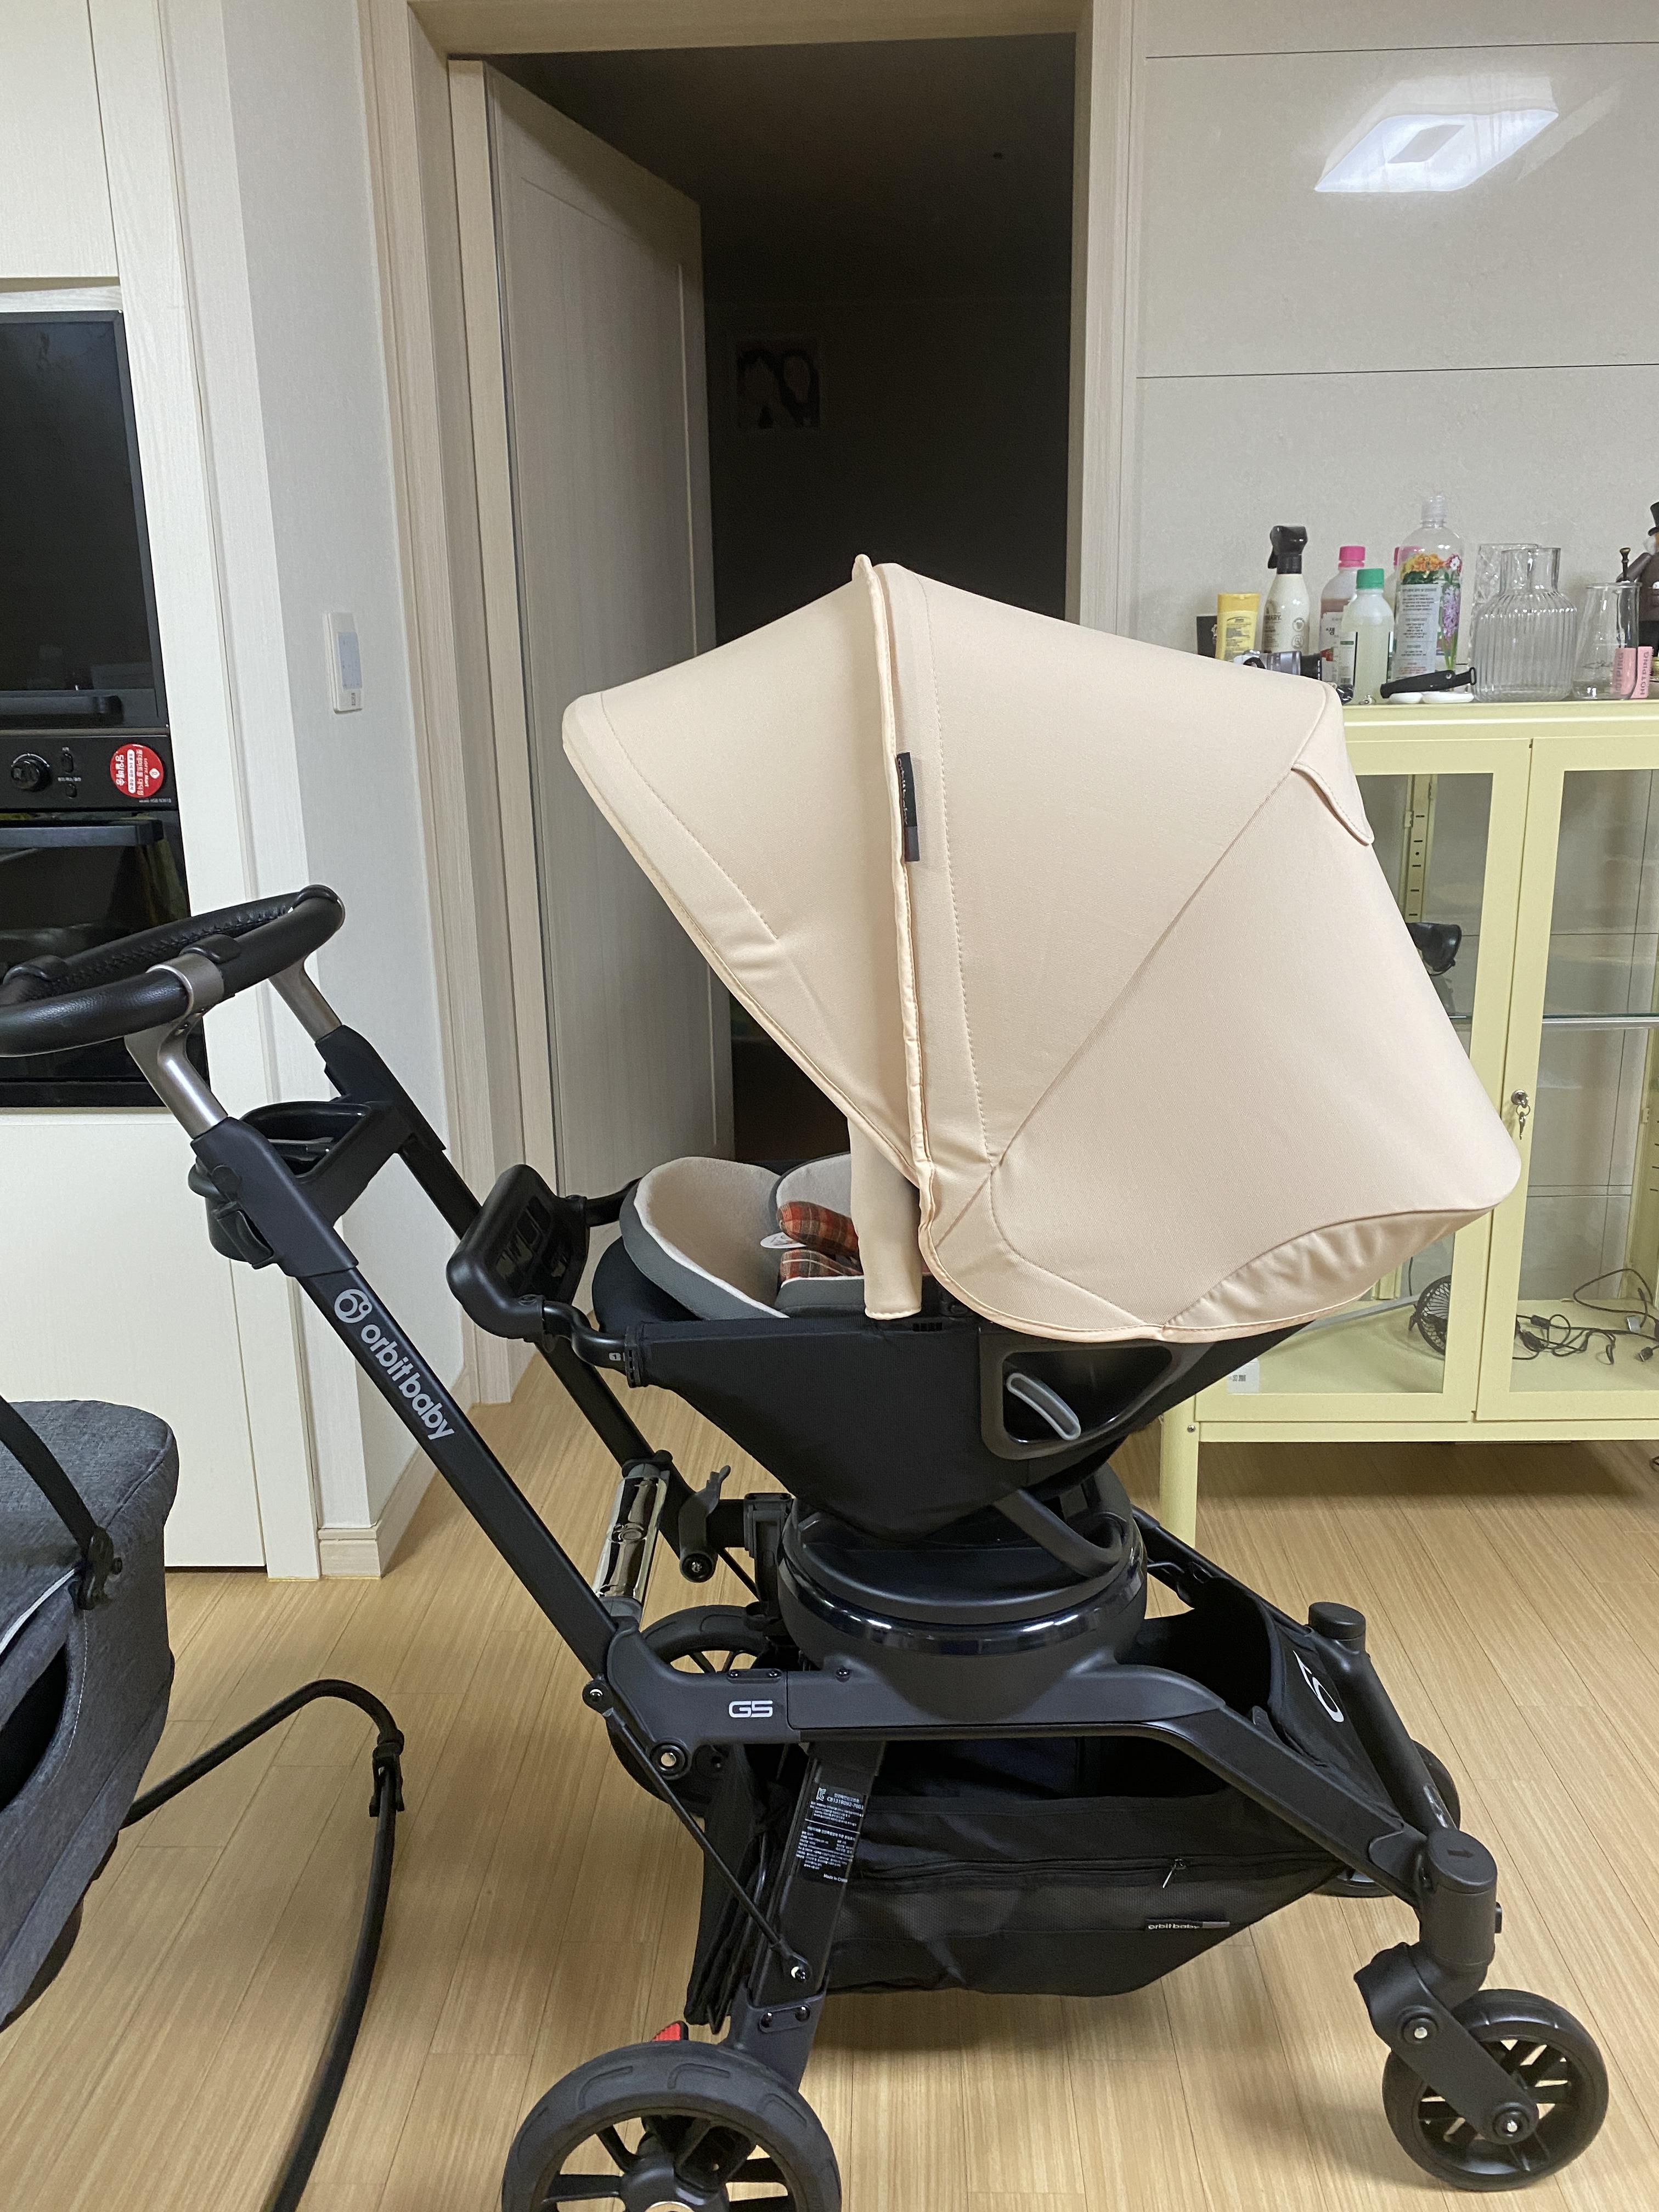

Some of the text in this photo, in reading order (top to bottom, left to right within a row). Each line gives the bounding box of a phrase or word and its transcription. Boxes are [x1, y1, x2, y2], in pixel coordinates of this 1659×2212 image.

[1640, 651, 1649, 695] HOTPING
[115, 754, 125, 786] 당일배송
[728, 1700, 773, 1718] G5
